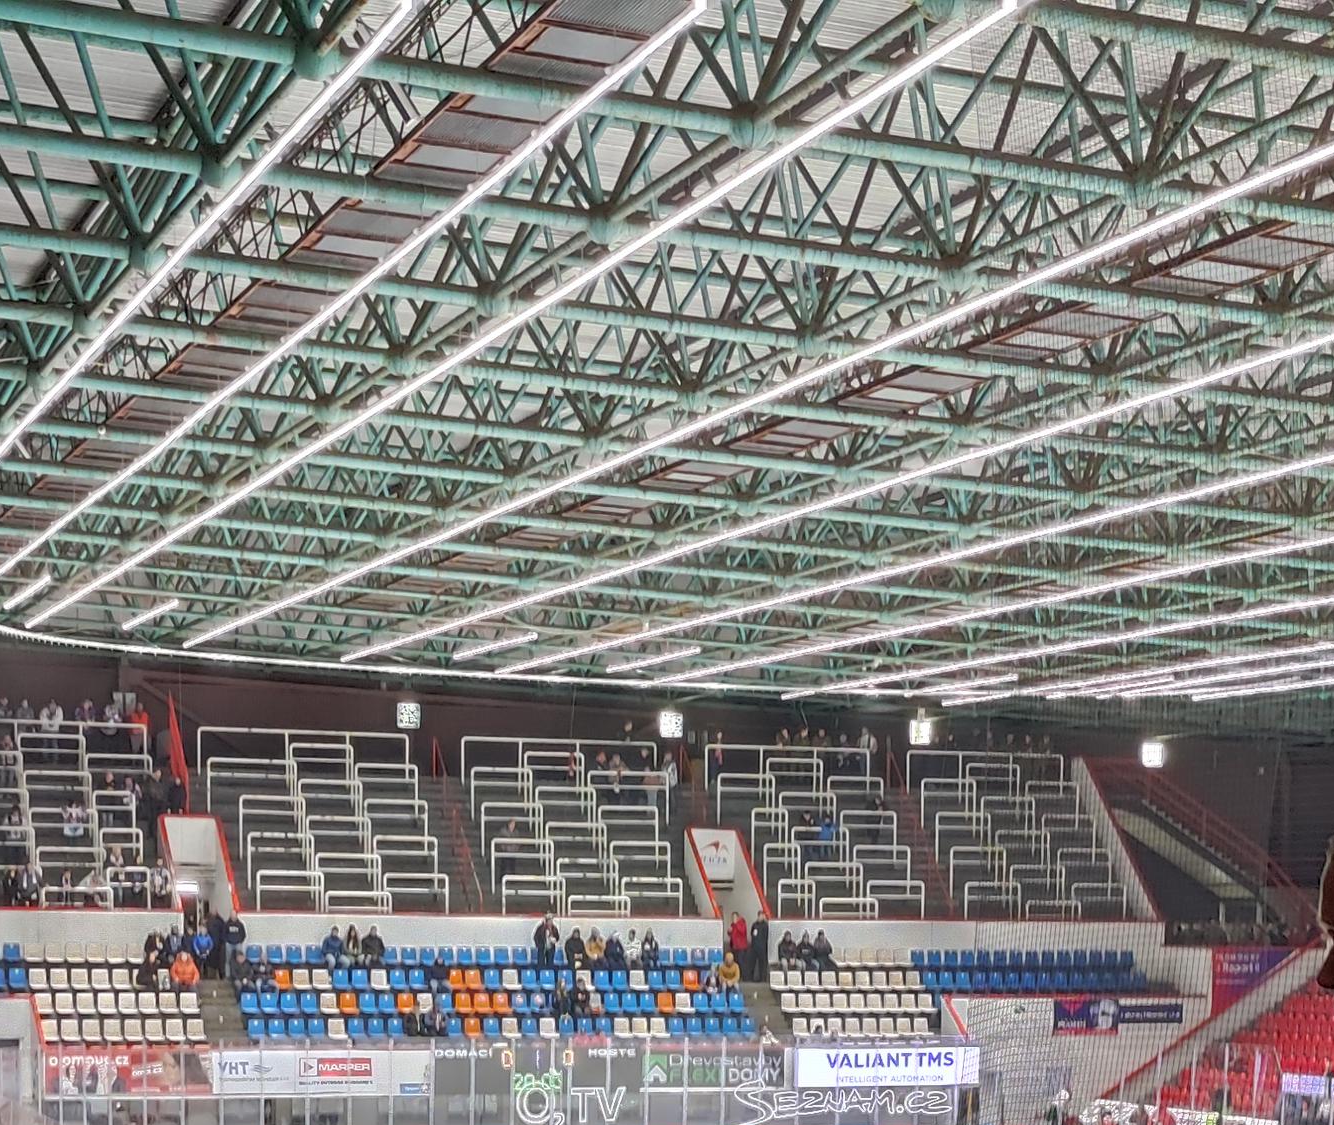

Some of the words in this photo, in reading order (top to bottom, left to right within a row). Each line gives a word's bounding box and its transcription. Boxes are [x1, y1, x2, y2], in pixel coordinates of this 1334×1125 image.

[826, 1052, 913, 1068] VALIANT
[917, 1052, 954, 1067] TMS
[728, 1067, 780, 1082] DOMY
[891, 1075, 944, 1083] AUTOMATION
[570, 1086, 627, 1123] TV
